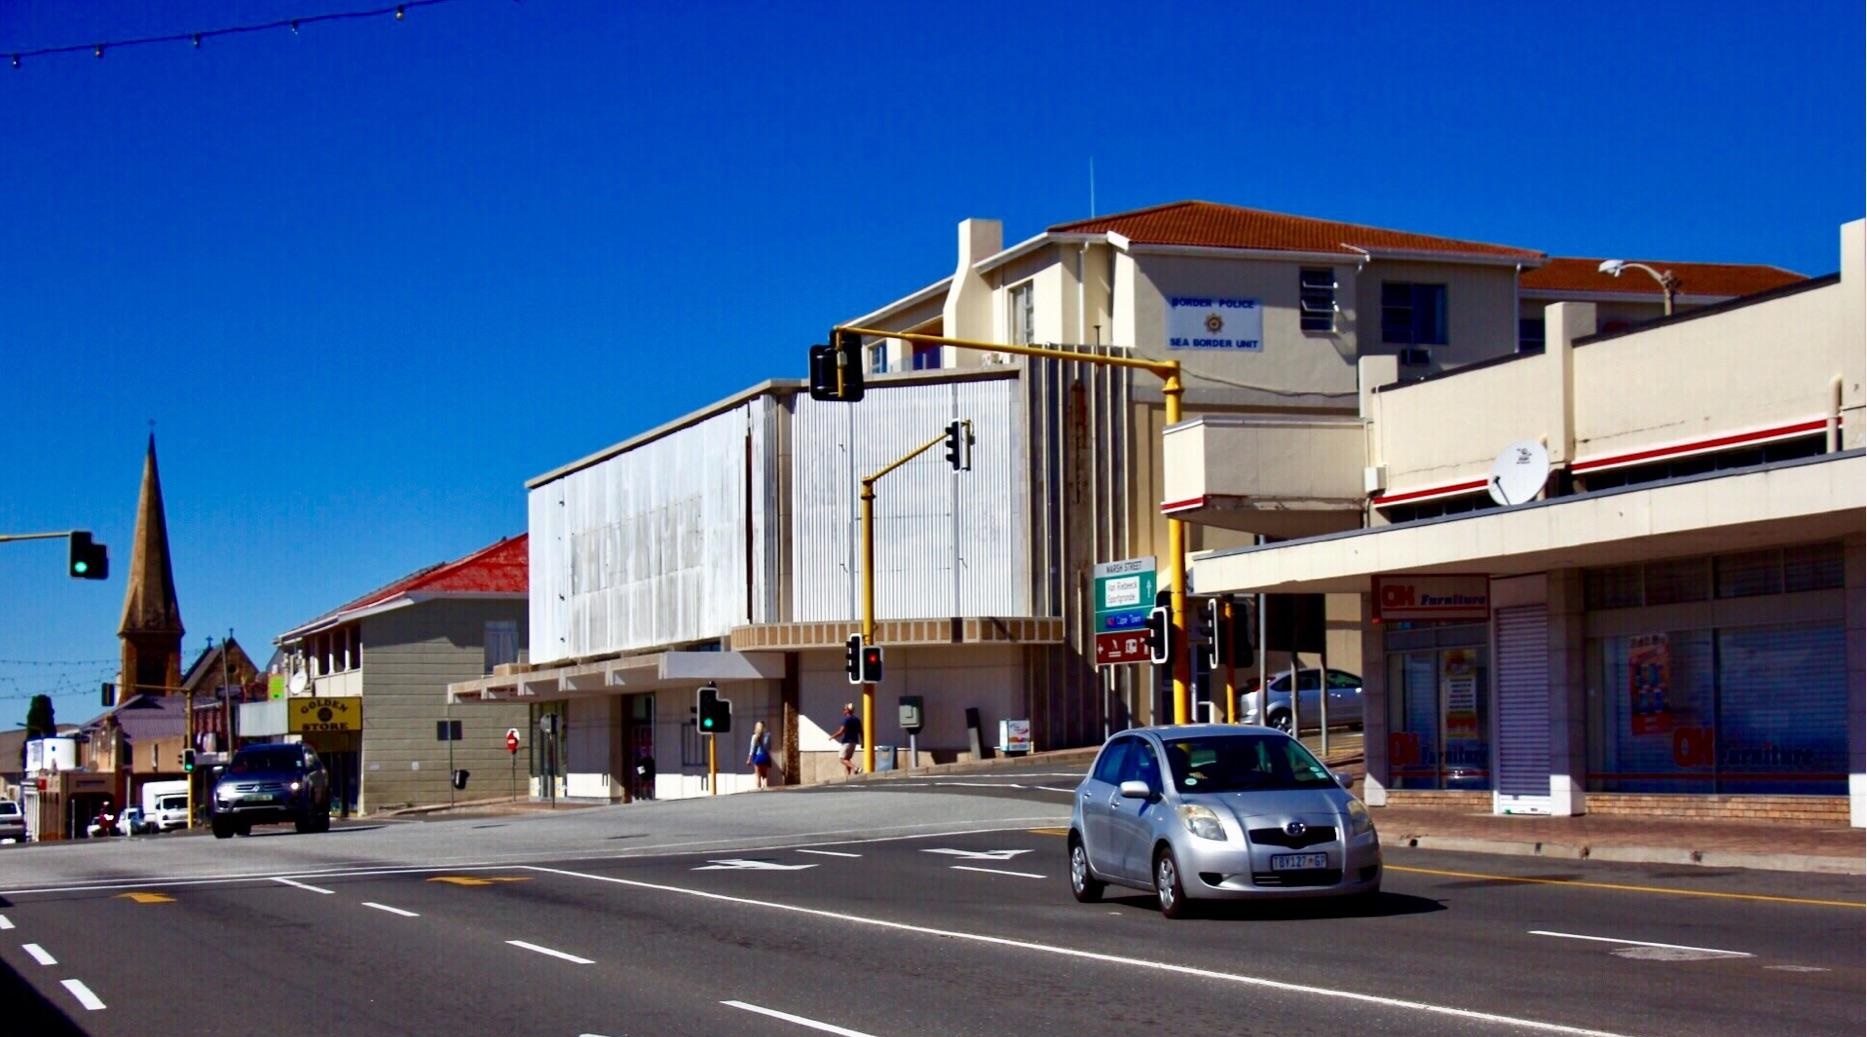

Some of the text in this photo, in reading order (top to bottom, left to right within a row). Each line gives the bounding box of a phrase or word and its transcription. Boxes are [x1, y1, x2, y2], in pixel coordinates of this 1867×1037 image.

[1171, 297, 1255, 309] BORDER POLICE
[1170, 338, 1259, 348] SEA BORDER UNIT
[1124, 560, 1143, 572] STREET
[1381, 584, 1487, 607] OK Furniture
[301, 699, 349, 714] GOLDEN
[302, 722, 349, 731] STORE
[1673, 727, 1715, 767] OK
